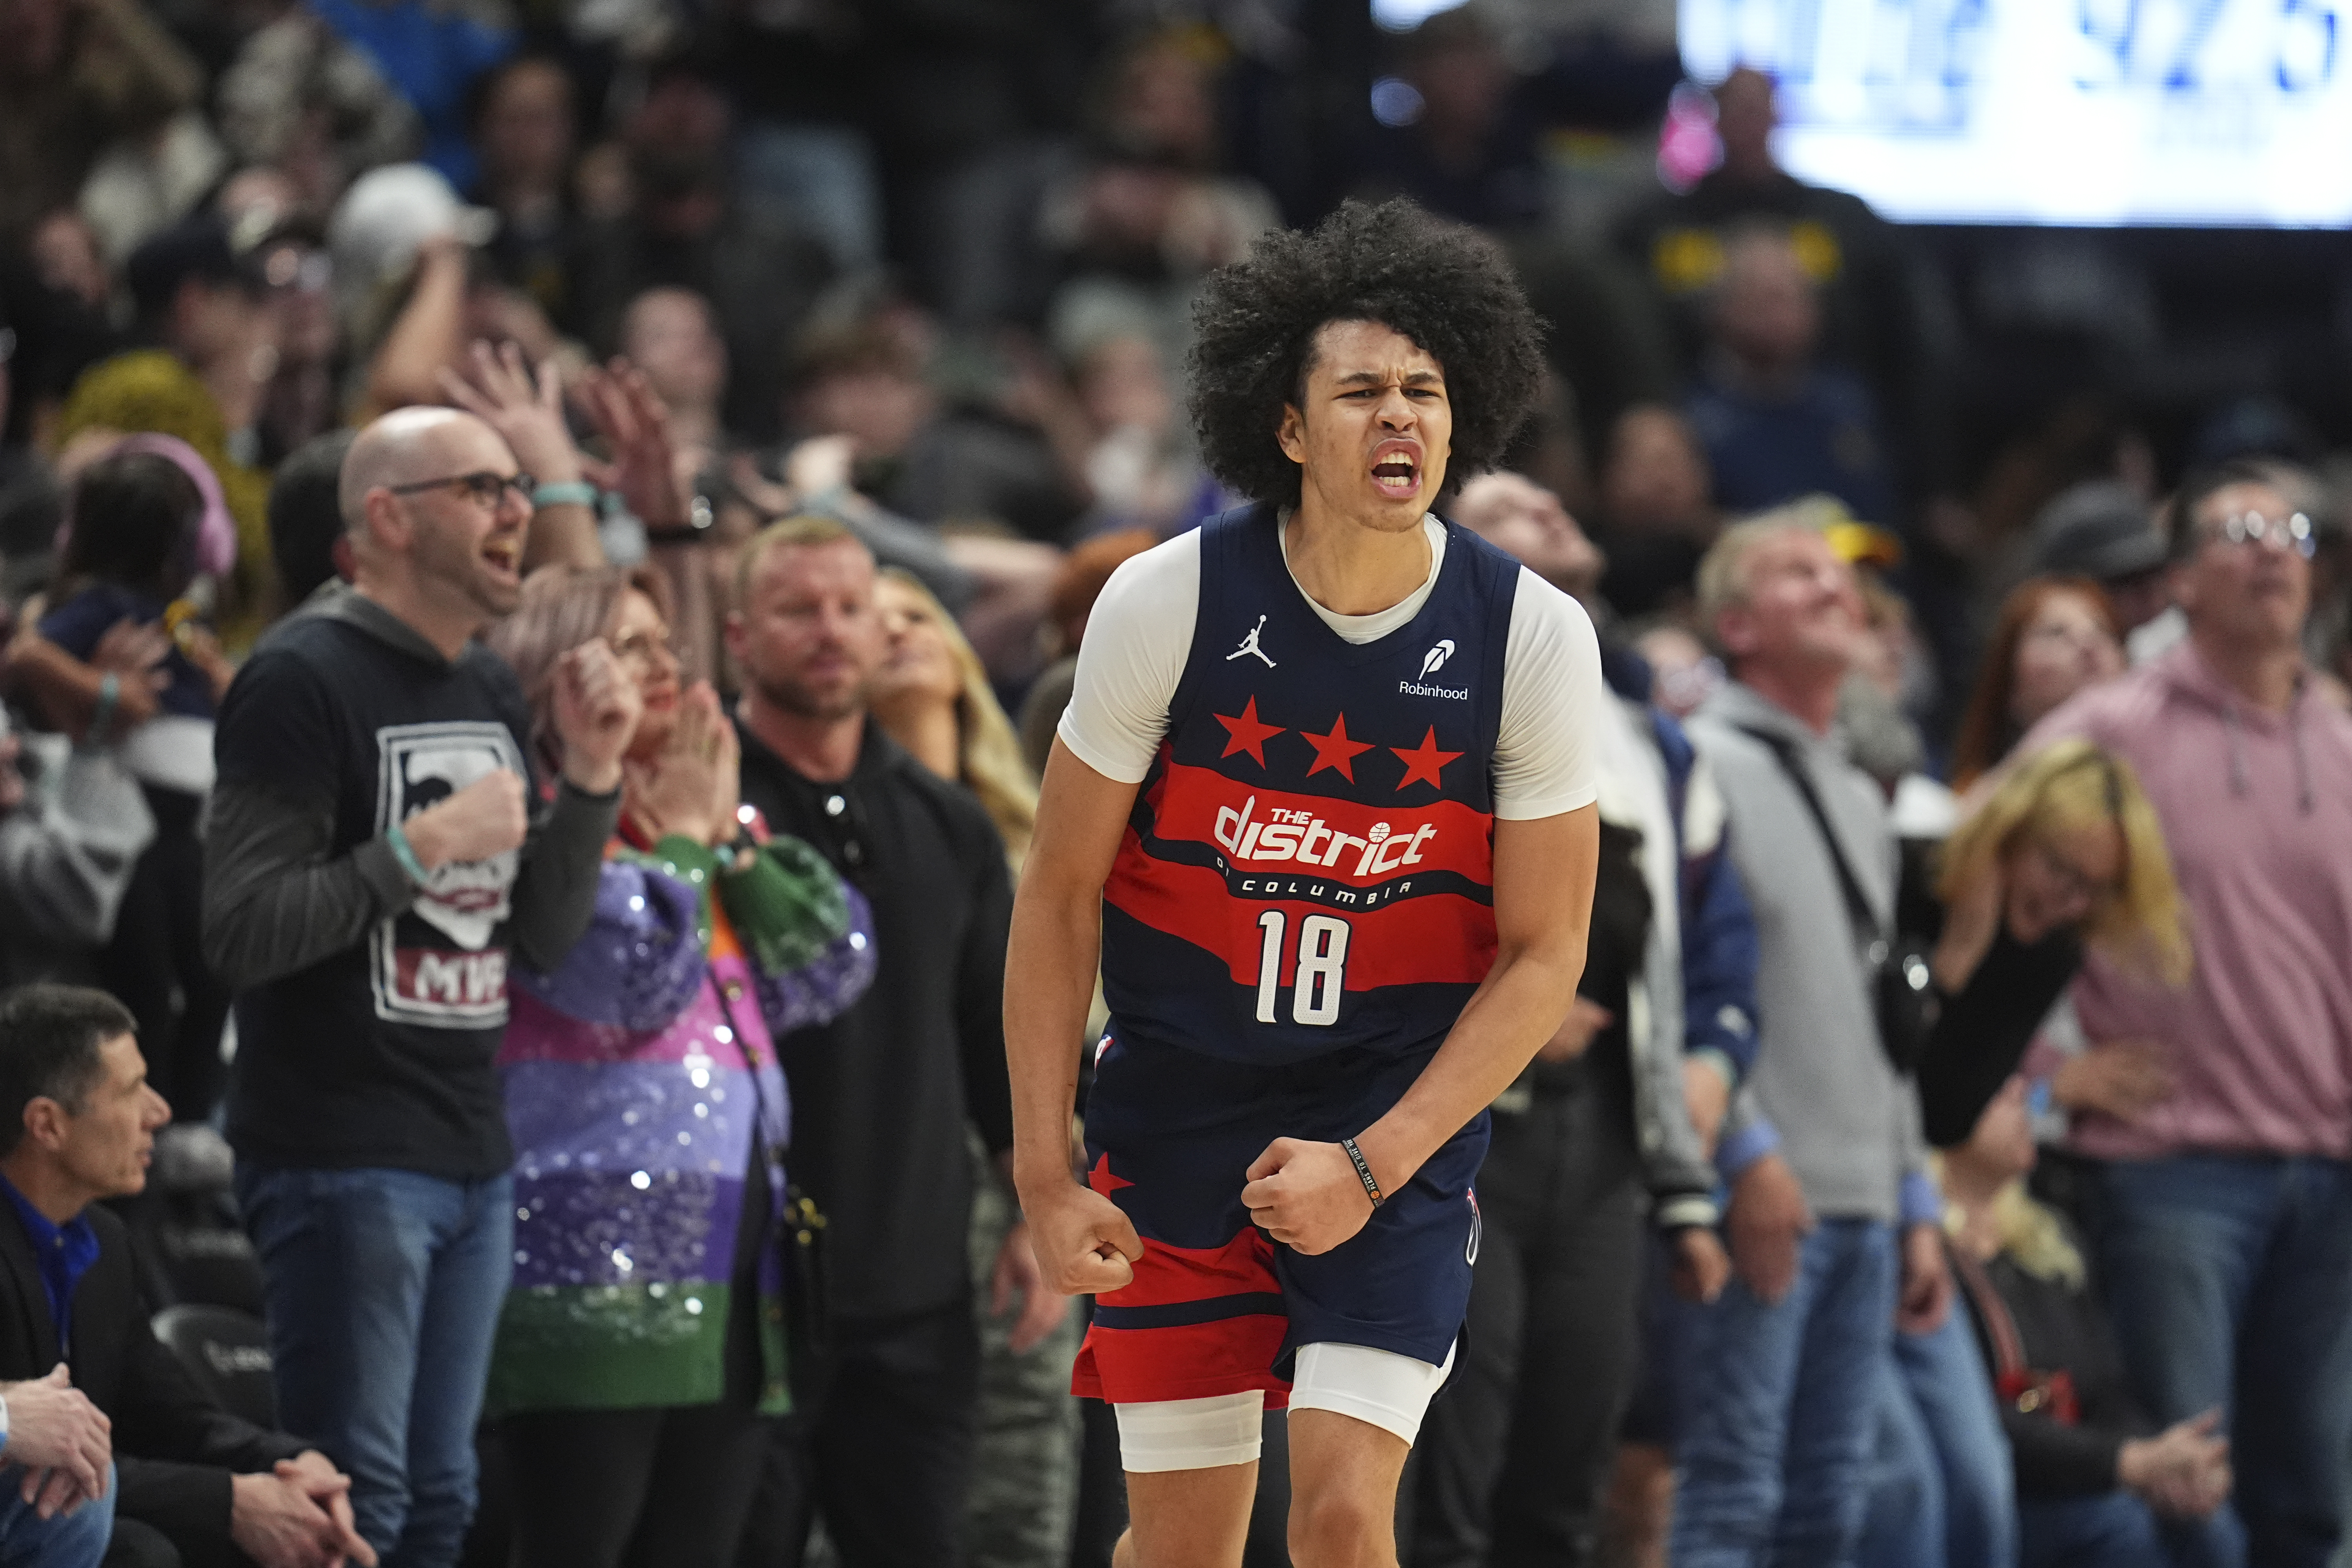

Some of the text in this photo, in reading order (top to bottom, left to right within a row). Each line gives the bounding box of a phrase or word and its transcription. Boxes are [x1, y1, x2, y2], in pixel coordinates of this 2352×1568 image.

[1399, 681, 1468, 700] Robinhood
[1271, 808, 1312, 824] THE
[1214, 795, 1438, 877] district
[1241, 880, 1412, 905] COLUMBIA
[1256, 911, 1350, 1026] 18
[1351, 1147, 1361, 1160] GIVE
[1359, 1162, 1366, 1170] TO
[1364, 1172, 1376, 1190] PLANS
